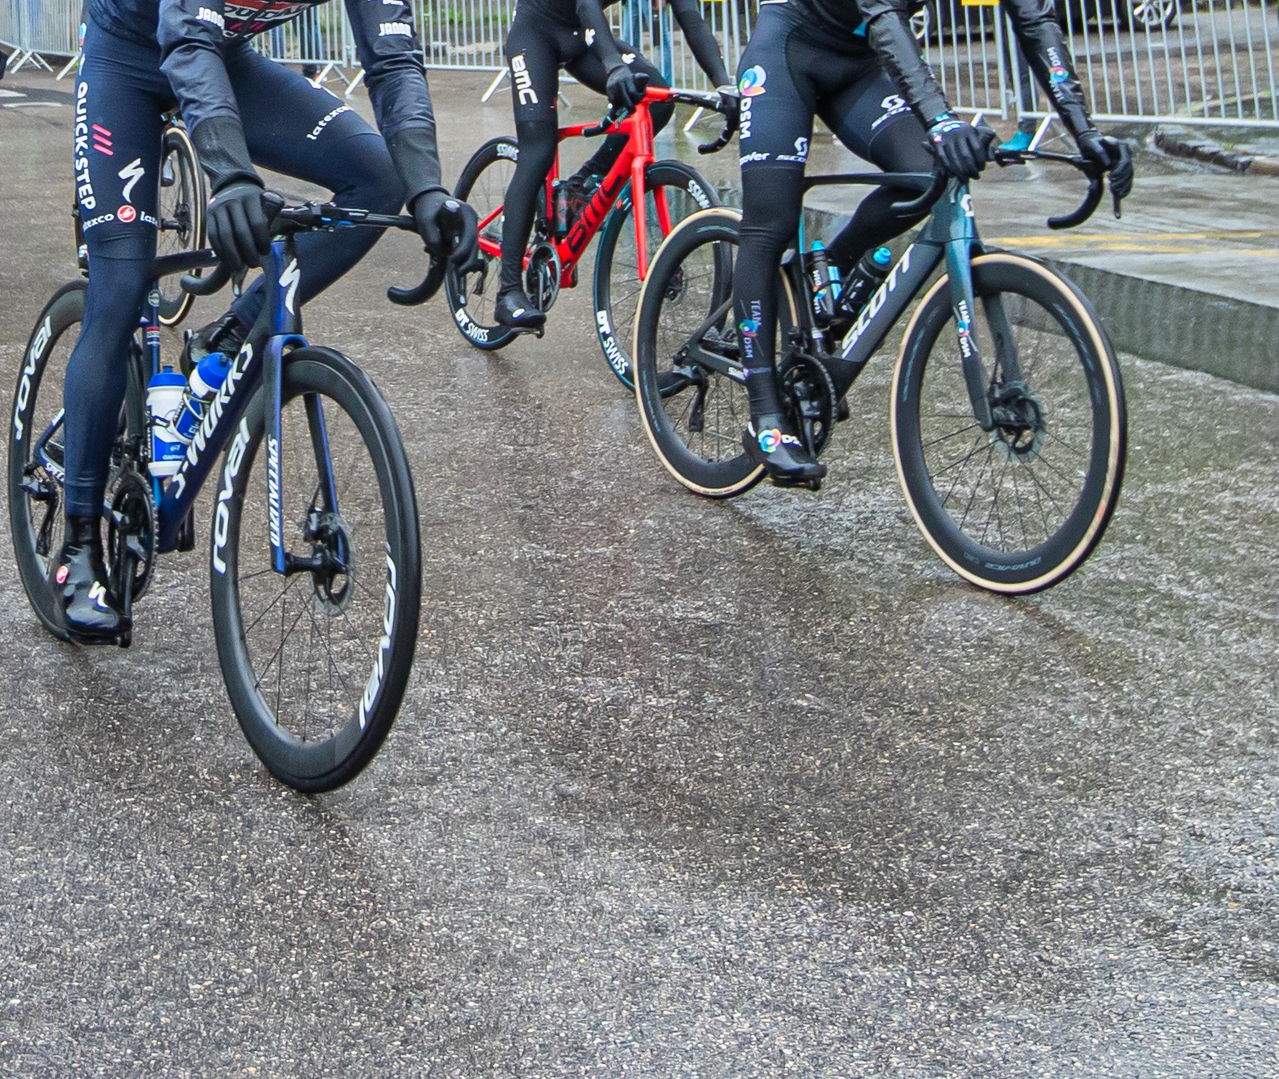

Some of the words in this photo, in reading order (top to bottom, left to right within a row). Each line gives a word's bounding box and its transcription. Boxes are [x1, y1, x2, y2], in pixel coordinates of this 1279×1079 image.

[511, 54, 539, 106] BMC
[740, 98, 752, 140] DSM
[841, 242, 916, 360] SCOTT
[465, 322, 490, 342] SWISS
[603, 337, 629, 375] SWISS
[15, 315, 53, 441] roval
[213, 416, 251, 575] roval
